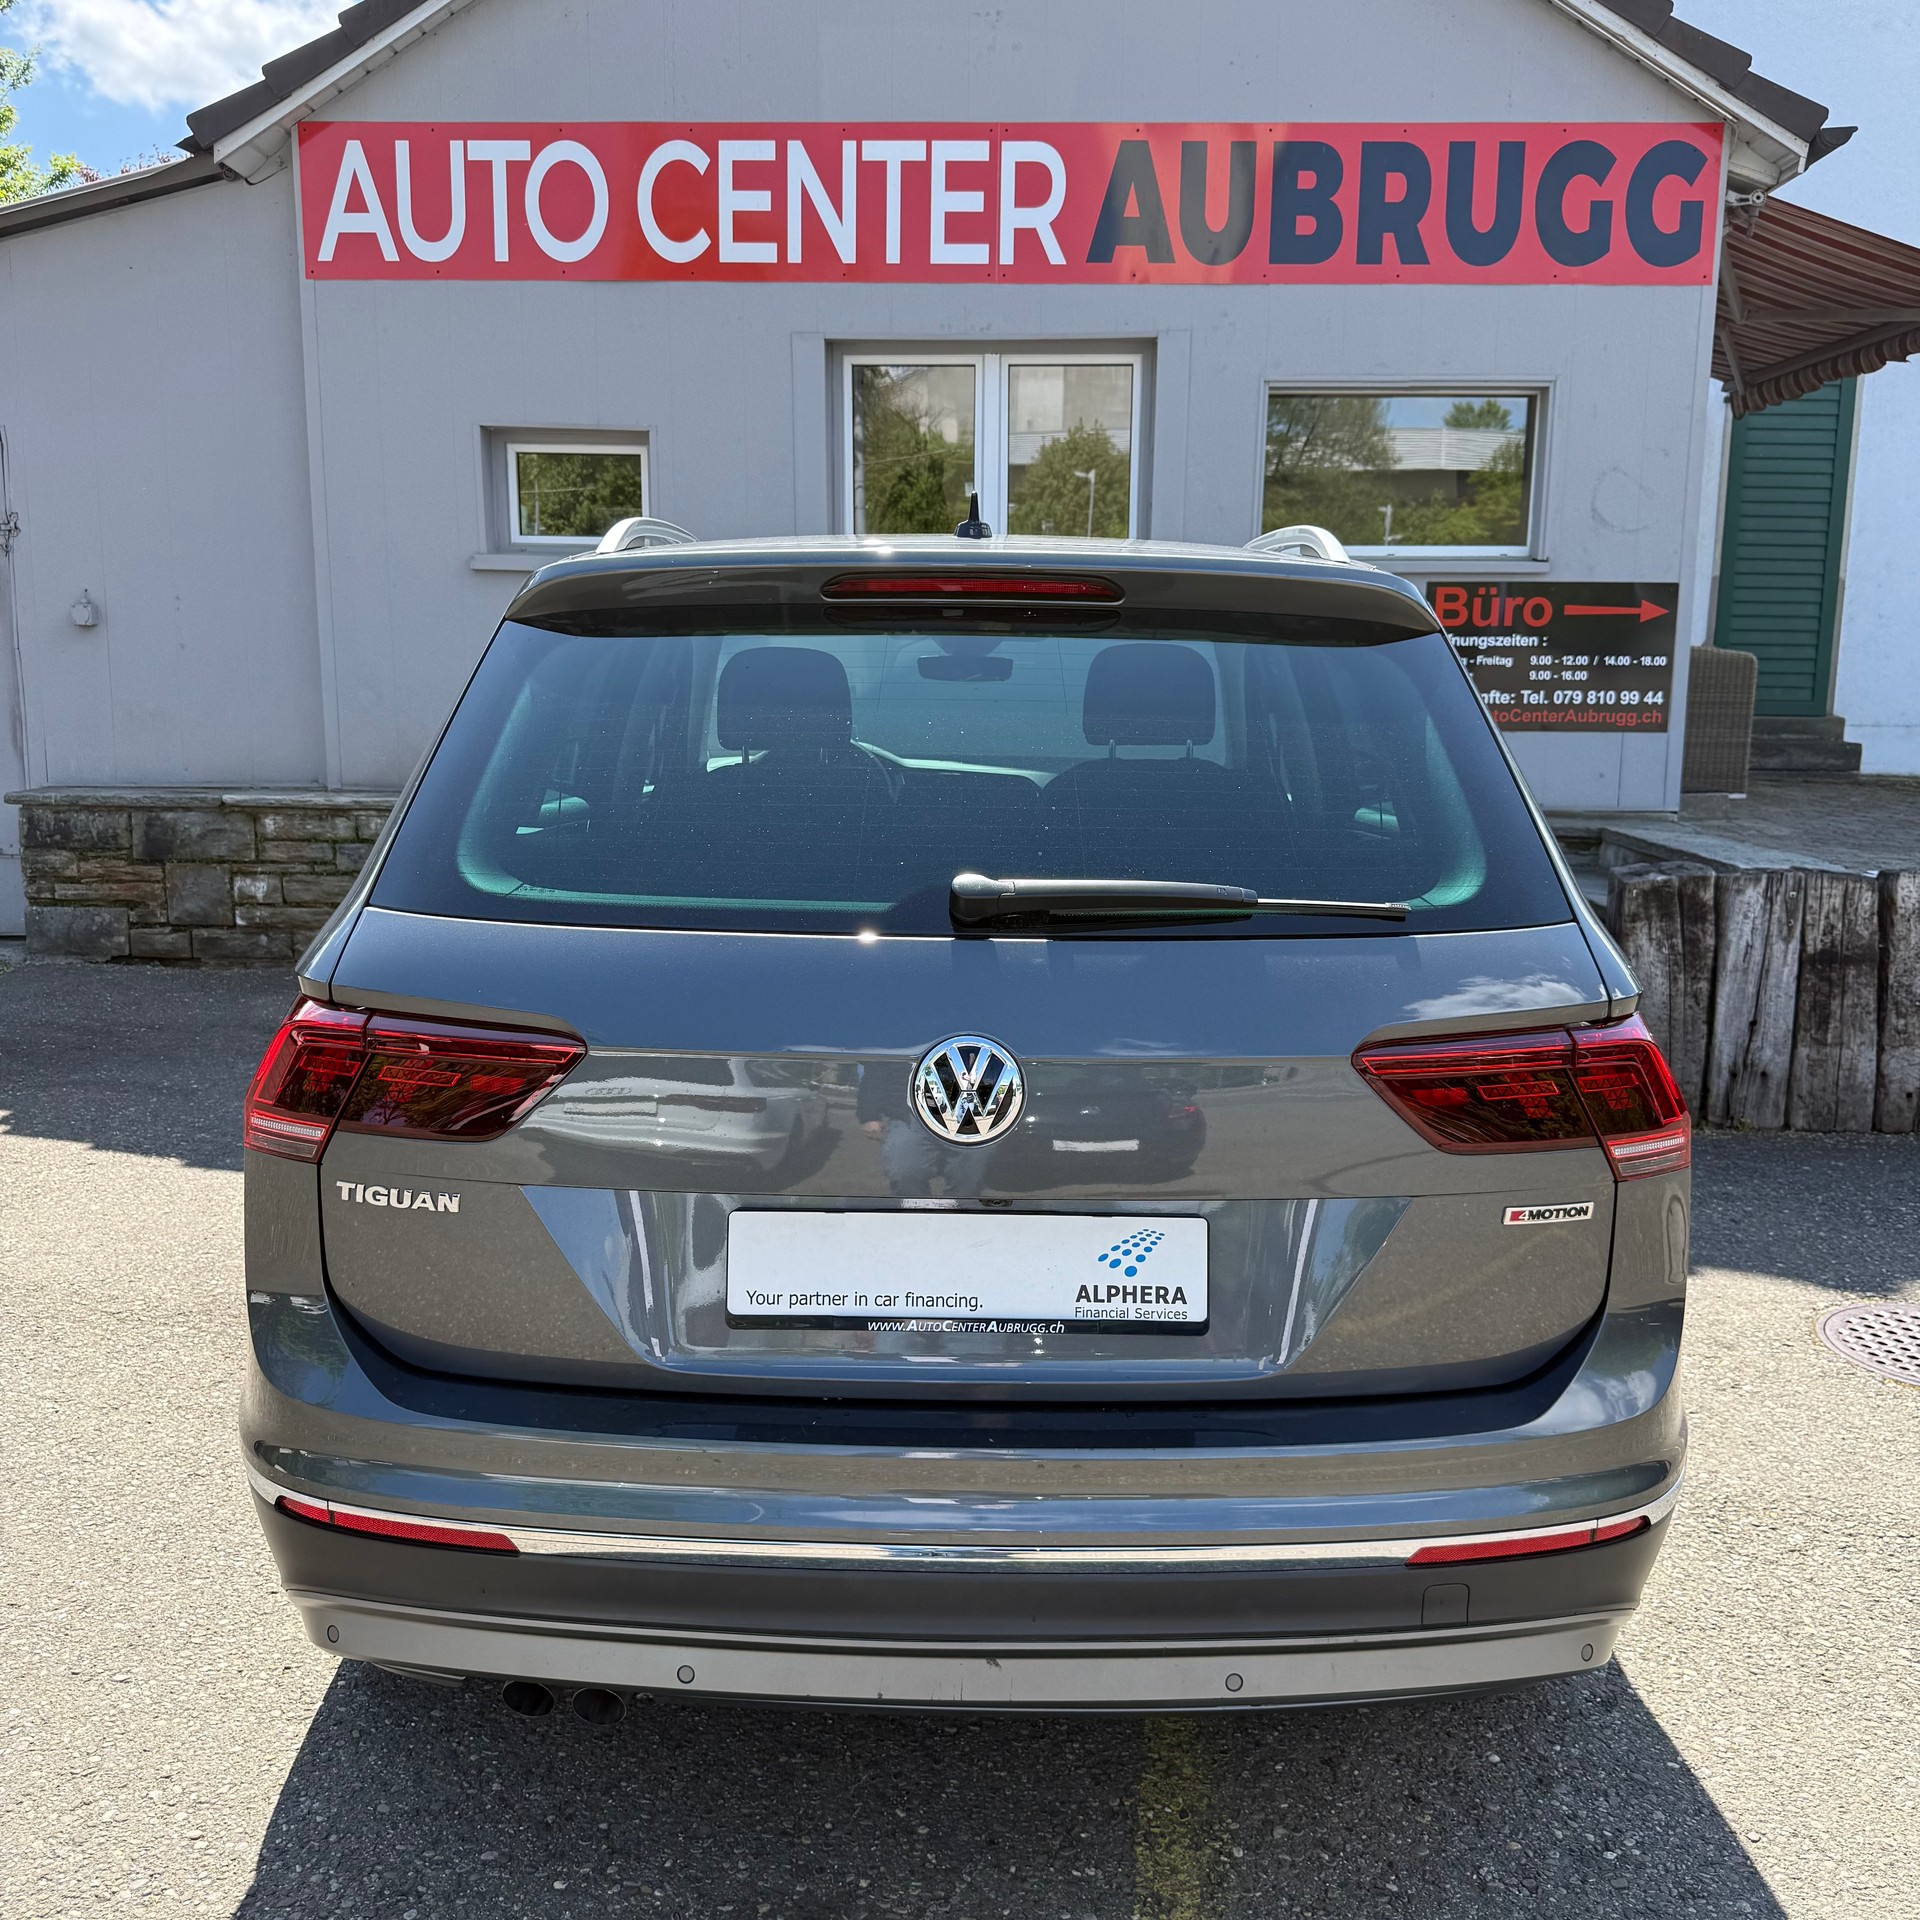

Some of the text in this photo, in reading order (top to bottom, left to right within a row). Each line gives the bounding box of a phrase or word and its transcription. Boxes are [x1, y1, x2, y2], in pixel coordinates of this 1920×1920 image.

[317, 139, 1709, 268] AUTO CENTER AUBRUGG
[1435, 586, 1553, 628] Büro
[1447, 632, 1539, 650] fnungszeiten
[1476, 655, 1514, 668] Freitag
[1529, 655, 1552, 666] 9.00
[1561, 655, 1589, 666] 12.00
[1603, 656, 1631, 666] 14.00
[1640, 656, 1668, 667] 18.00
[1528, 670, 1552, 681] 9.00
[1560, 670, 1588, 681] 16.00
[1480, 689, 1664, 706] nfte: Tel. 079 810 99 44
[1491, 709, 1663, 727] toCenterAubrugg.ch
[336, 1180, 461, 1213] TIGUAN
[746, 1290, 983, 1312] Your partner in car financing.
[1075, 1284, 1188, 1305] ALPHERA
[1074, 1306, 1188, 1320] Financial Services
